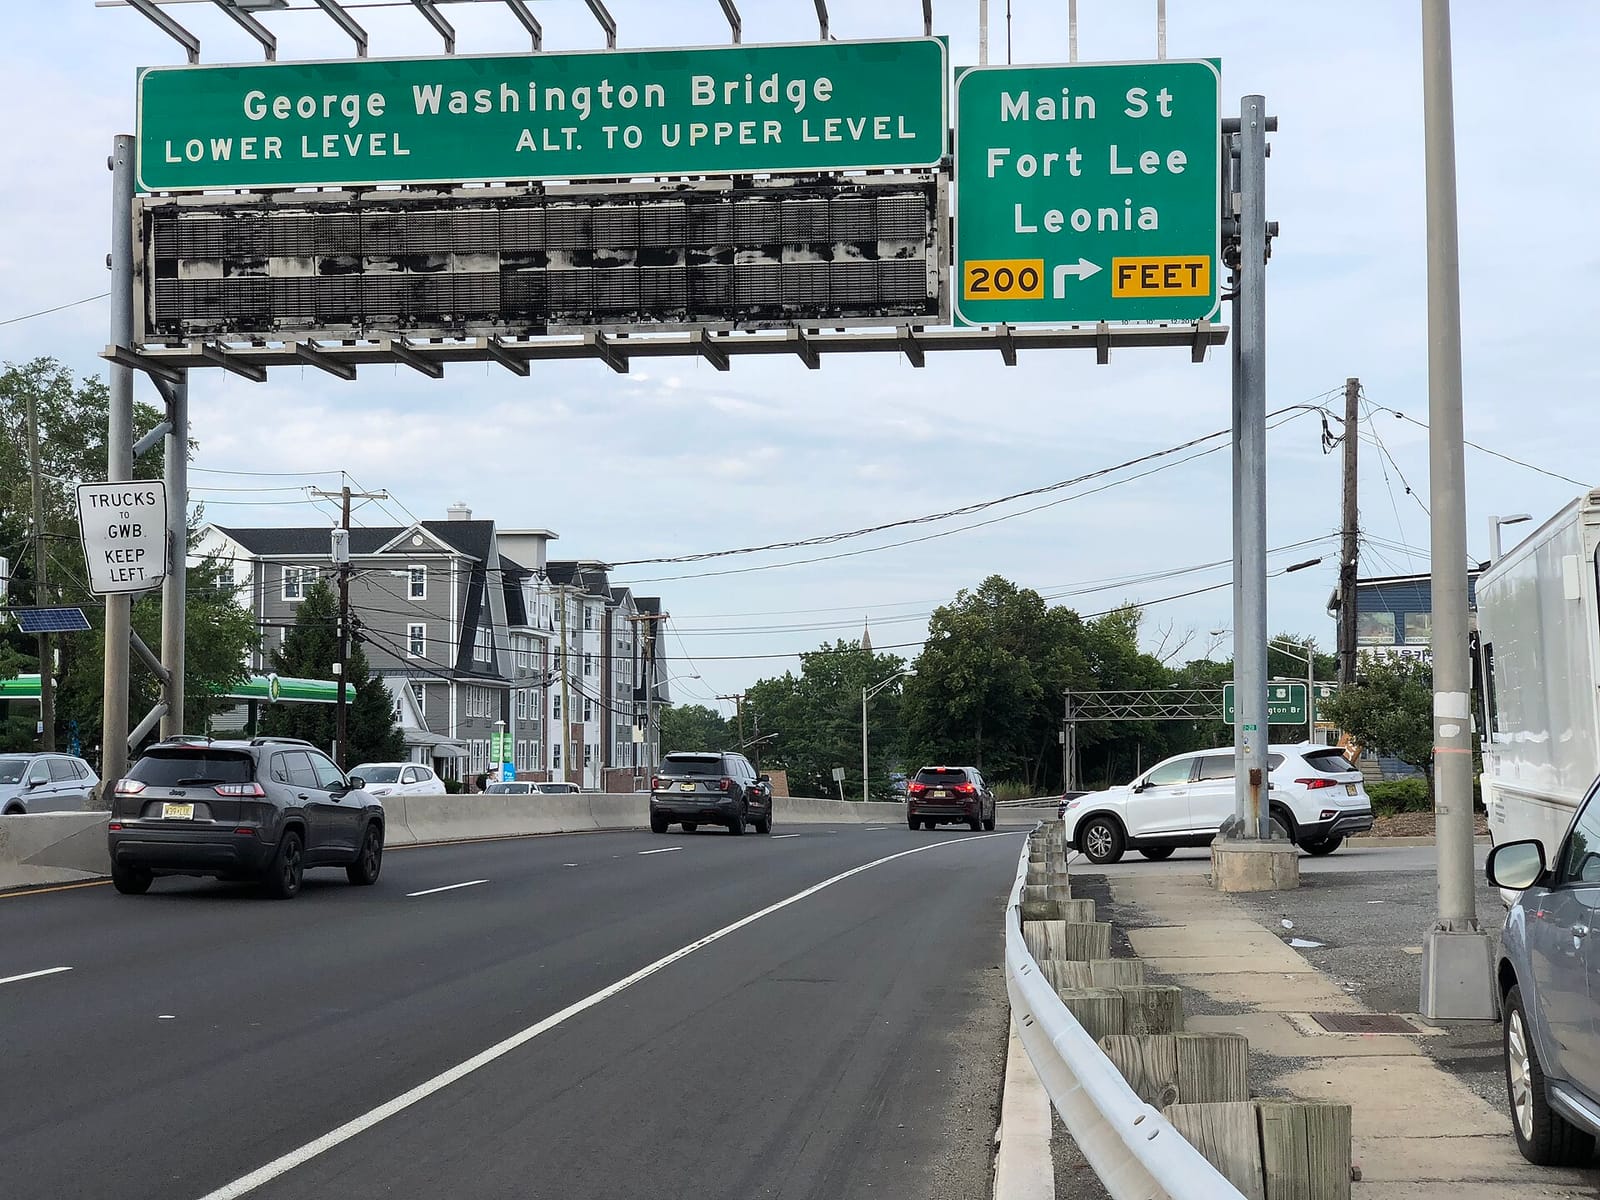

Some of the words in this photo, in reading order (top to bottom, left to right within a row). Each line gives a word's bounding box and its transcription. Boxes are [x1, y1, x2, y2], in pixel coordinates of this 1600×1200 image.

[243, 90, 386, 129] George
[412, 79, 666, 121] Washington
[691, 72, 834, 115] Bridge
[1001, 87, 1096, 122] Main
[1124, 87, 1174, 118] St
[165, 136, 282, 163] LOWER
[301, 132, 410, 159] LEVEL
[515, 127, 582, 152] ALT.
[601, 125, 643, 149] TO
[661, 120, 782, 147] UPPER
[802, 115, 916, 143] LEVEL
[987, 146, 1082, 178] Fort
[1110, 144, 1188, 175] Lee
[1014, 198, 1158, 233] Leonia
[969, 267, 1039, 293] 200
[1118, 263, 1203, 289] FEET
[89, 491, 156, 508] TRUCKS
[119, 511, 130, 519] TO
[108, 523, 142, 538] GWB
[105, 548, 145, 564] KEEP
[110, 567, 145, 582] LEFT
